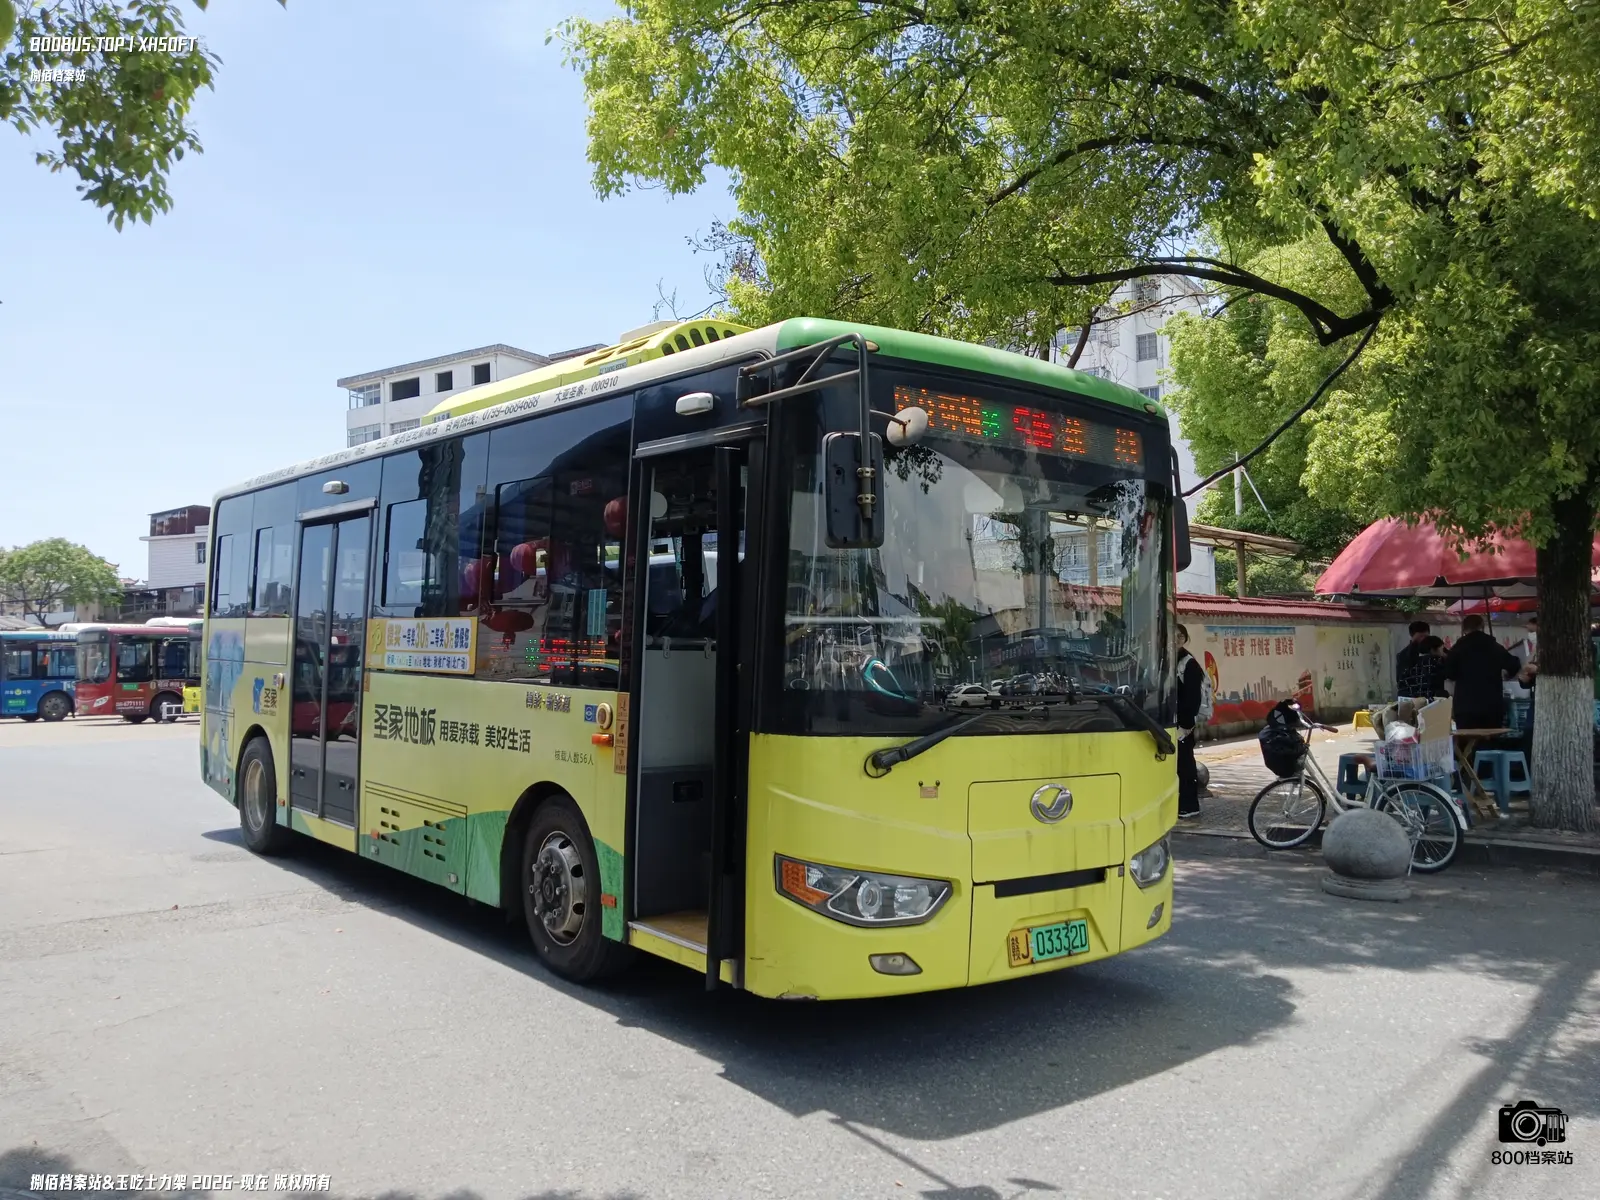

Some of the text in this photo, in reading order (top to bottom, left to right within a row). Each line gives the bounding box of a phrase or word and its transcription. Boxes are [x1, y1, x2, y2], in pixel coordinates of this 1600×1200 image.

[374, 703, 531, 753] 圣象地板 用爱承载 美好生活
